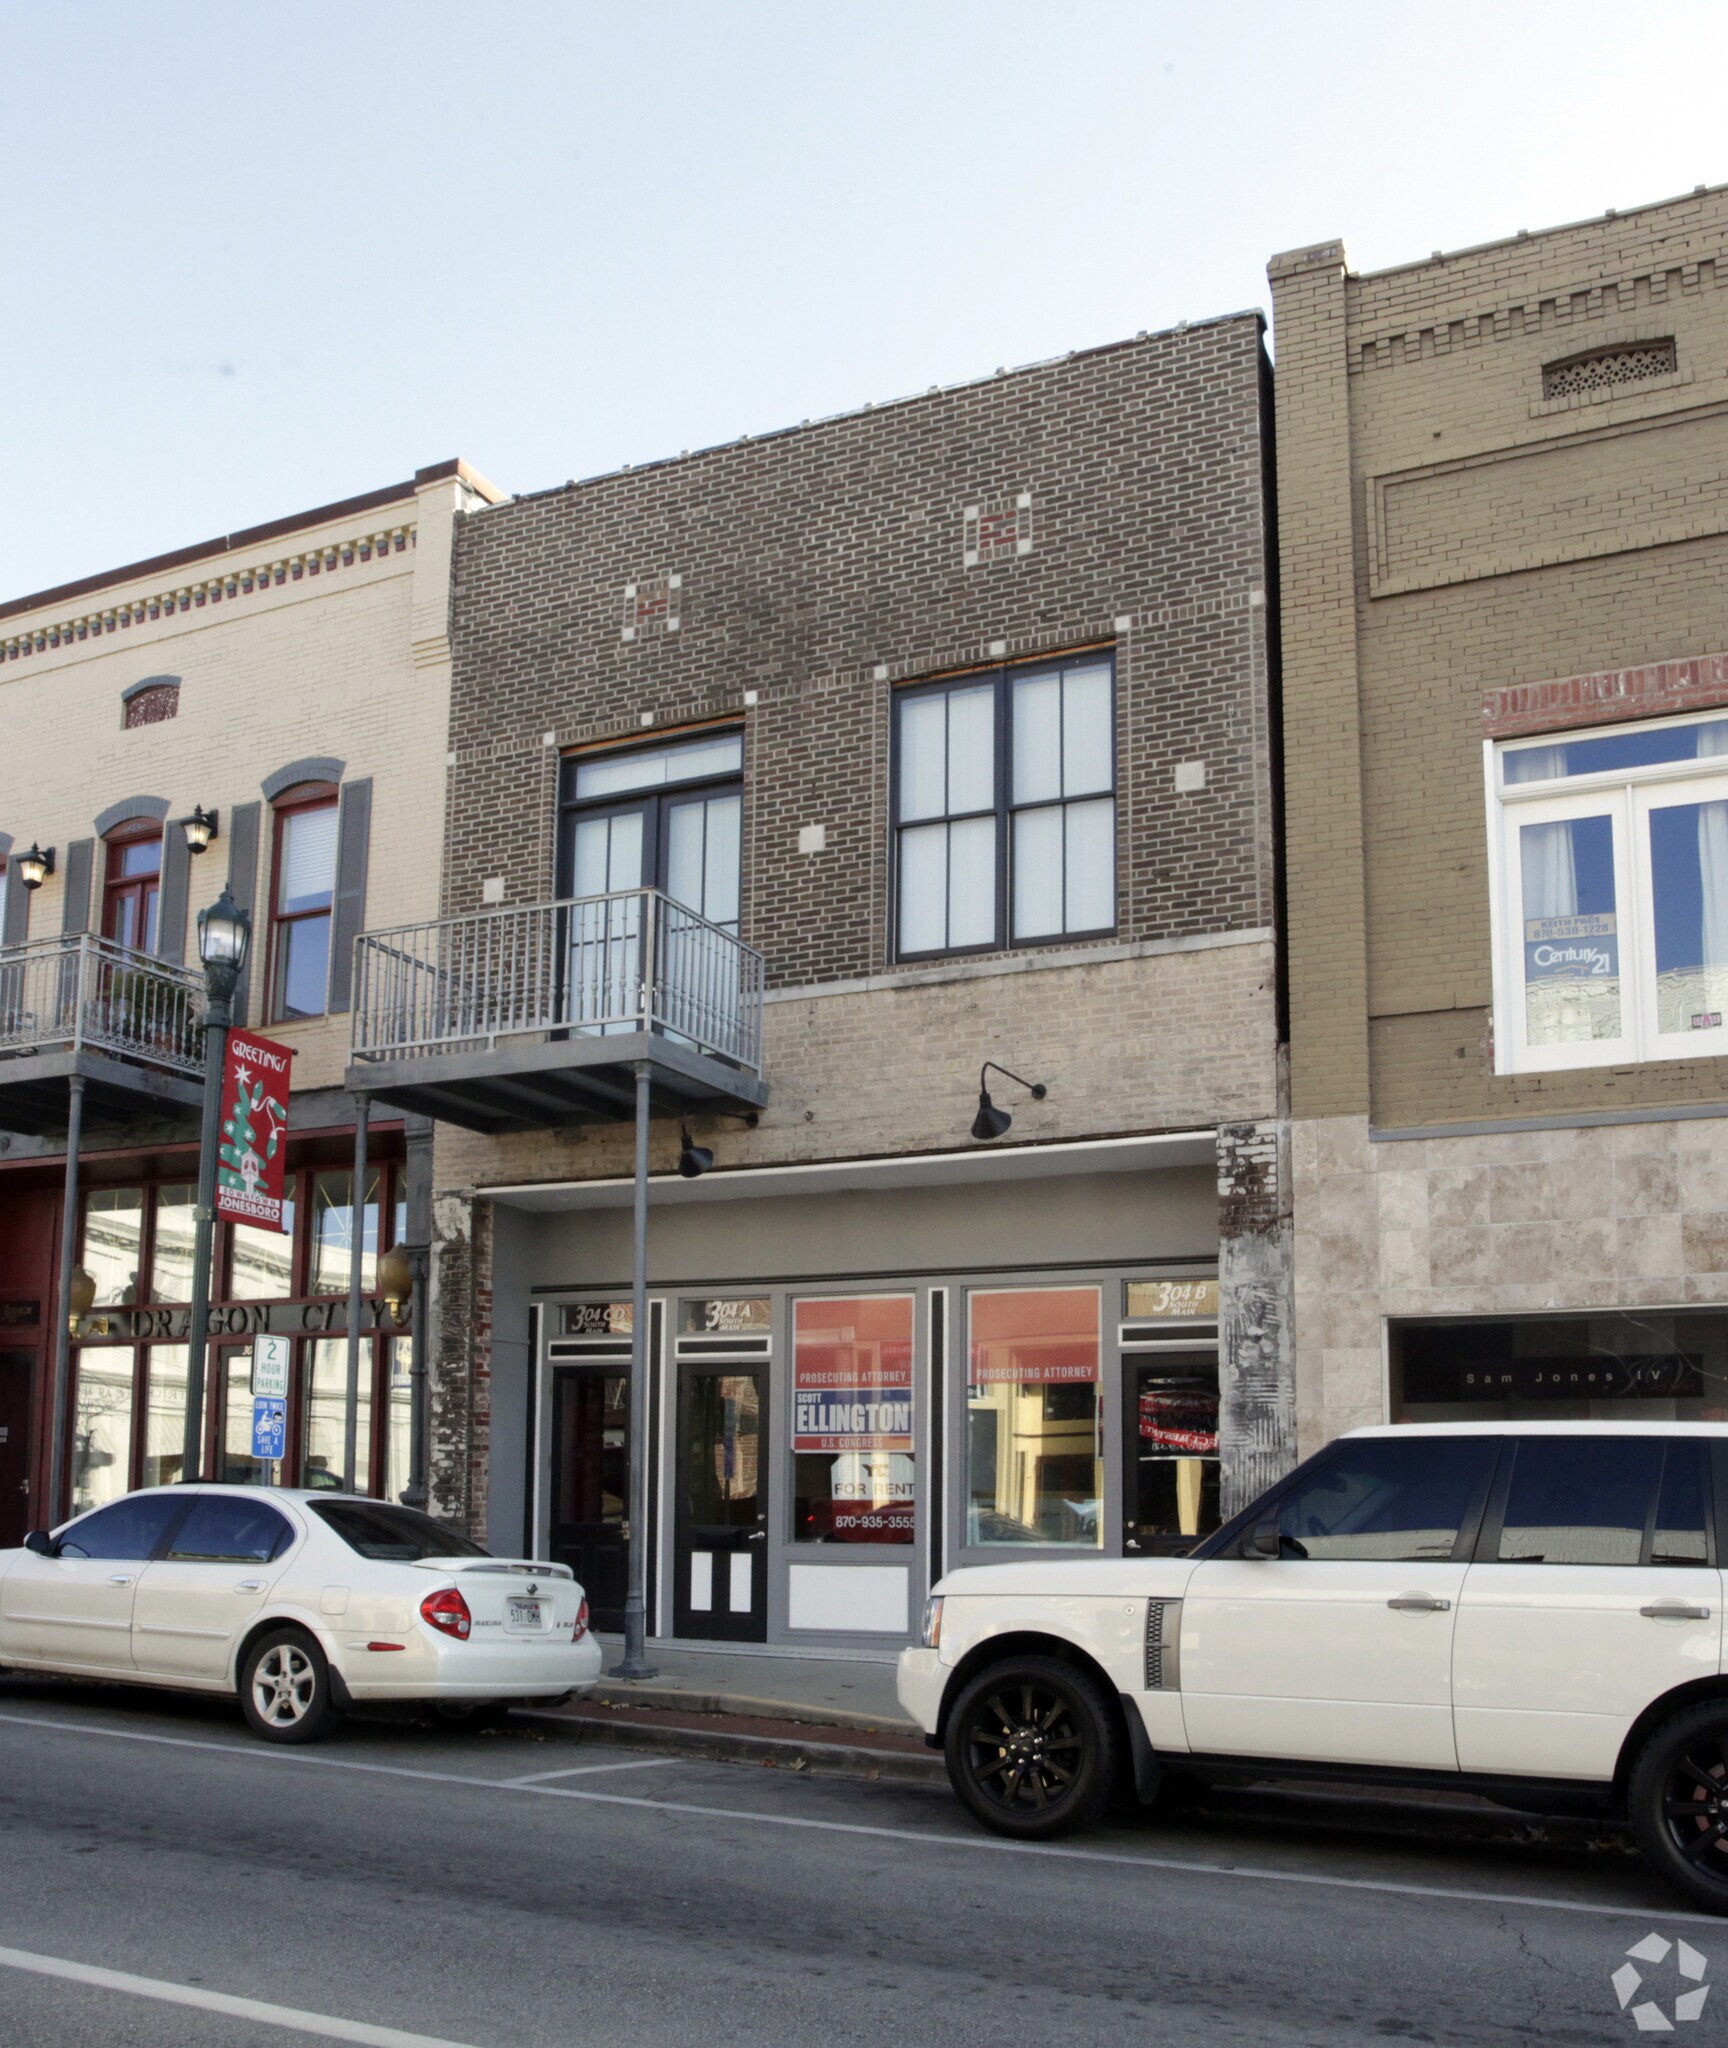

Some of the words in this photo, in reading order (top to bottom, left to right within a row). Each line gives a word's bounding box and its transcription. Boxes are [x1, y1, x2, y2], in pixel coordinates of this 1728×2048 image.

[1534, 945, 1598, 967] Century
[1591, 953, 1610, 974] 21
[232, 1039, 287, 1072] GREETINGS
[223, 1187, 277, 1207] DOWNTOWN
[219, 1197, 280, 1220] JONESBORO
[1153, 1282, 1190, 1312] 304
[1196, 1286, 1207, 1300] B
[1169, 1300, 1199, 1309] SOUTH
[302, 1300, 386, 1331] CIY
[571, 1305, 601, 1331] 304
[603, 1308, 626, 1321] CD
[705, 1301, 737, 1327] 304
[741, 1304, 751, 1318] A
[1170, 1307, 1196, 1316] MAIN
[242, 1345, 253, 1356] 30
[267, 1342, 277, 1360] 2
[261, 1363, 281, 1374] HOUR
[976, 1368, 1040, 1380] PROSECUTING
[1043, 1366, 1093, 1378] ATTORNEY
[256, 1377, 283, 1391] PARKING
[800, 1372, 858, 1384] PROSECUTING
[861, 1371, 906, 1382] ATTORNEY
[1466, 1373, 1513, 1384] Sam
[1535, 1371, 1613, 1383] Jones
[797, 1393, 822, 1404] SCOTT
[255, 1401, 268, 1410] LOOK
[269, 1402, 284, 1411] TWICE
[797, 1403, 909, 1433] ELLINGTON
[257, 1435, 271, 1445] SAVE
[274, 1437, 279, 1446] A
[821, 1438, 836, 1449] U.S.
[839, 1437, 883, 1448] CONGRESS
[261, 1445, 274, 1455] LIFE
[834, 1483, 866, 1495] FOR
[873, 1483, 914, 1495] RENT
[835, 1516, 915, 1528] 870-935-3555
[510, 1610, 523, 1623] 531
